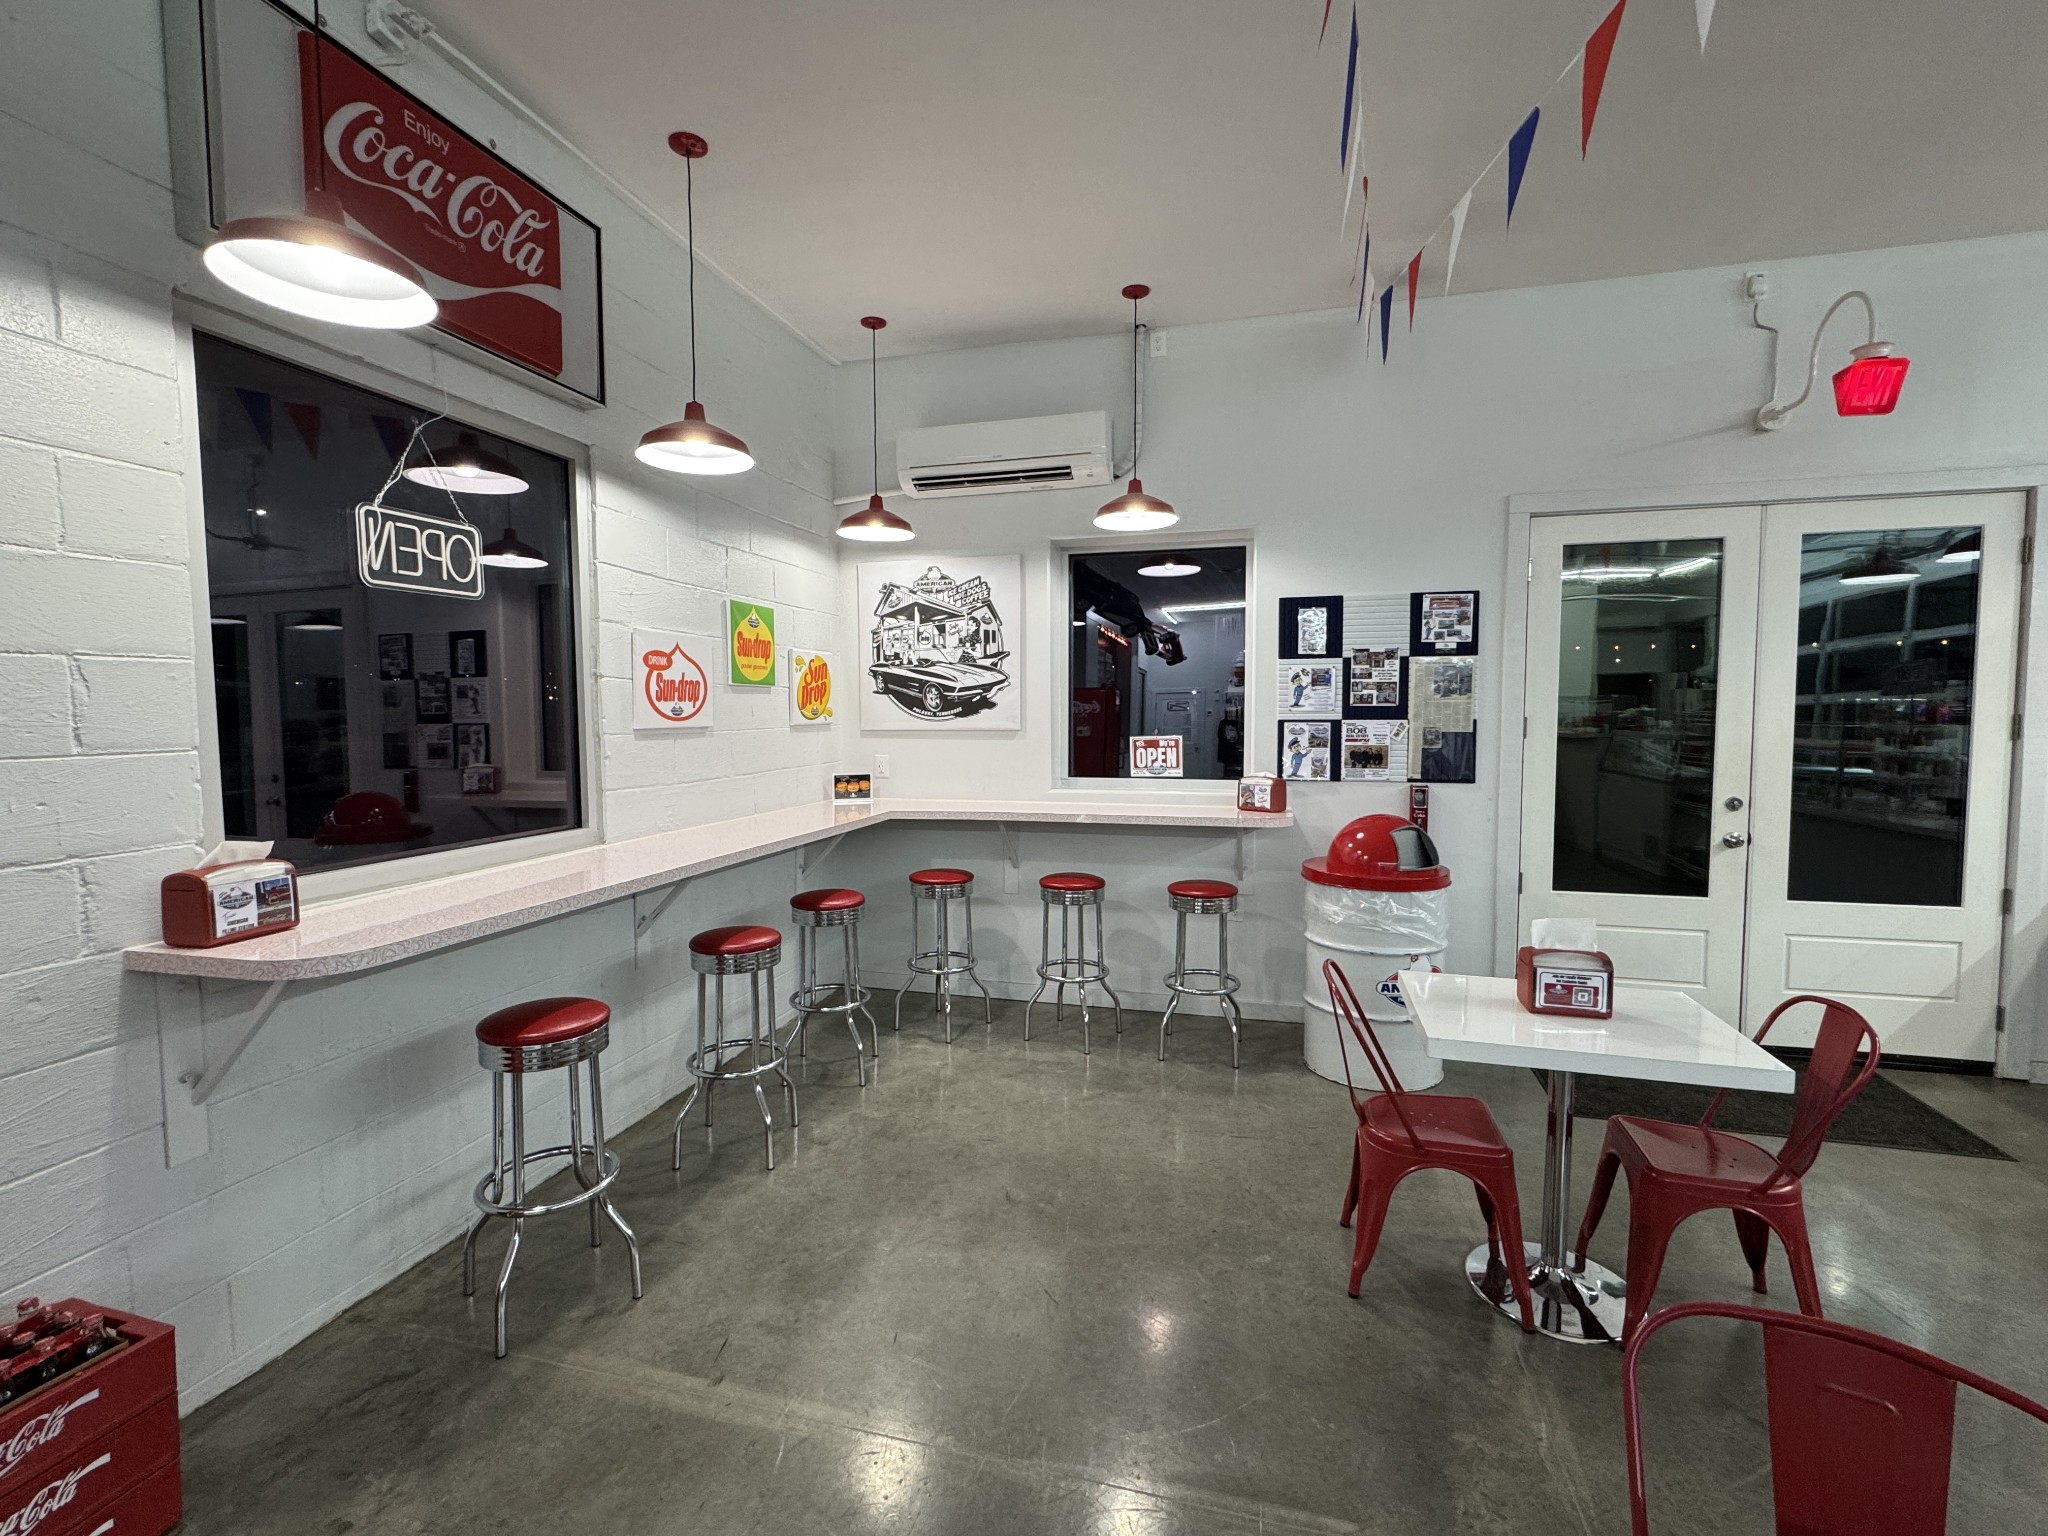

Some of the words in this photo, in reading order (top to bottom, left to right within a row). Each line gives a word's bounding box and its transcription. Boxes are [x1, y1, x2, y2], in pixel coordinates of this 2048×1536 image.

[403, 108, 450, 155] Enjoy
[324, 101, 551, 278] Coca-Cola
[958, 577, 980, 592] CREAM
[967, 582, 987, 596] DOGS
[961, 588, 990, 605] COFFEE
[737, 631, 771, 664] Sun-drop
[648, 654, 668, 666] DRINK
[804, 658, 828, 686] Sun
[655, 671, 701, 708] Sun-drop
[800, 682, 827, 710] Drop
[1345, 727, 1368, 735] 808
[1135, 747, 1178, 769] OPEN
[220, 895, 254, 906] AMERICAN
